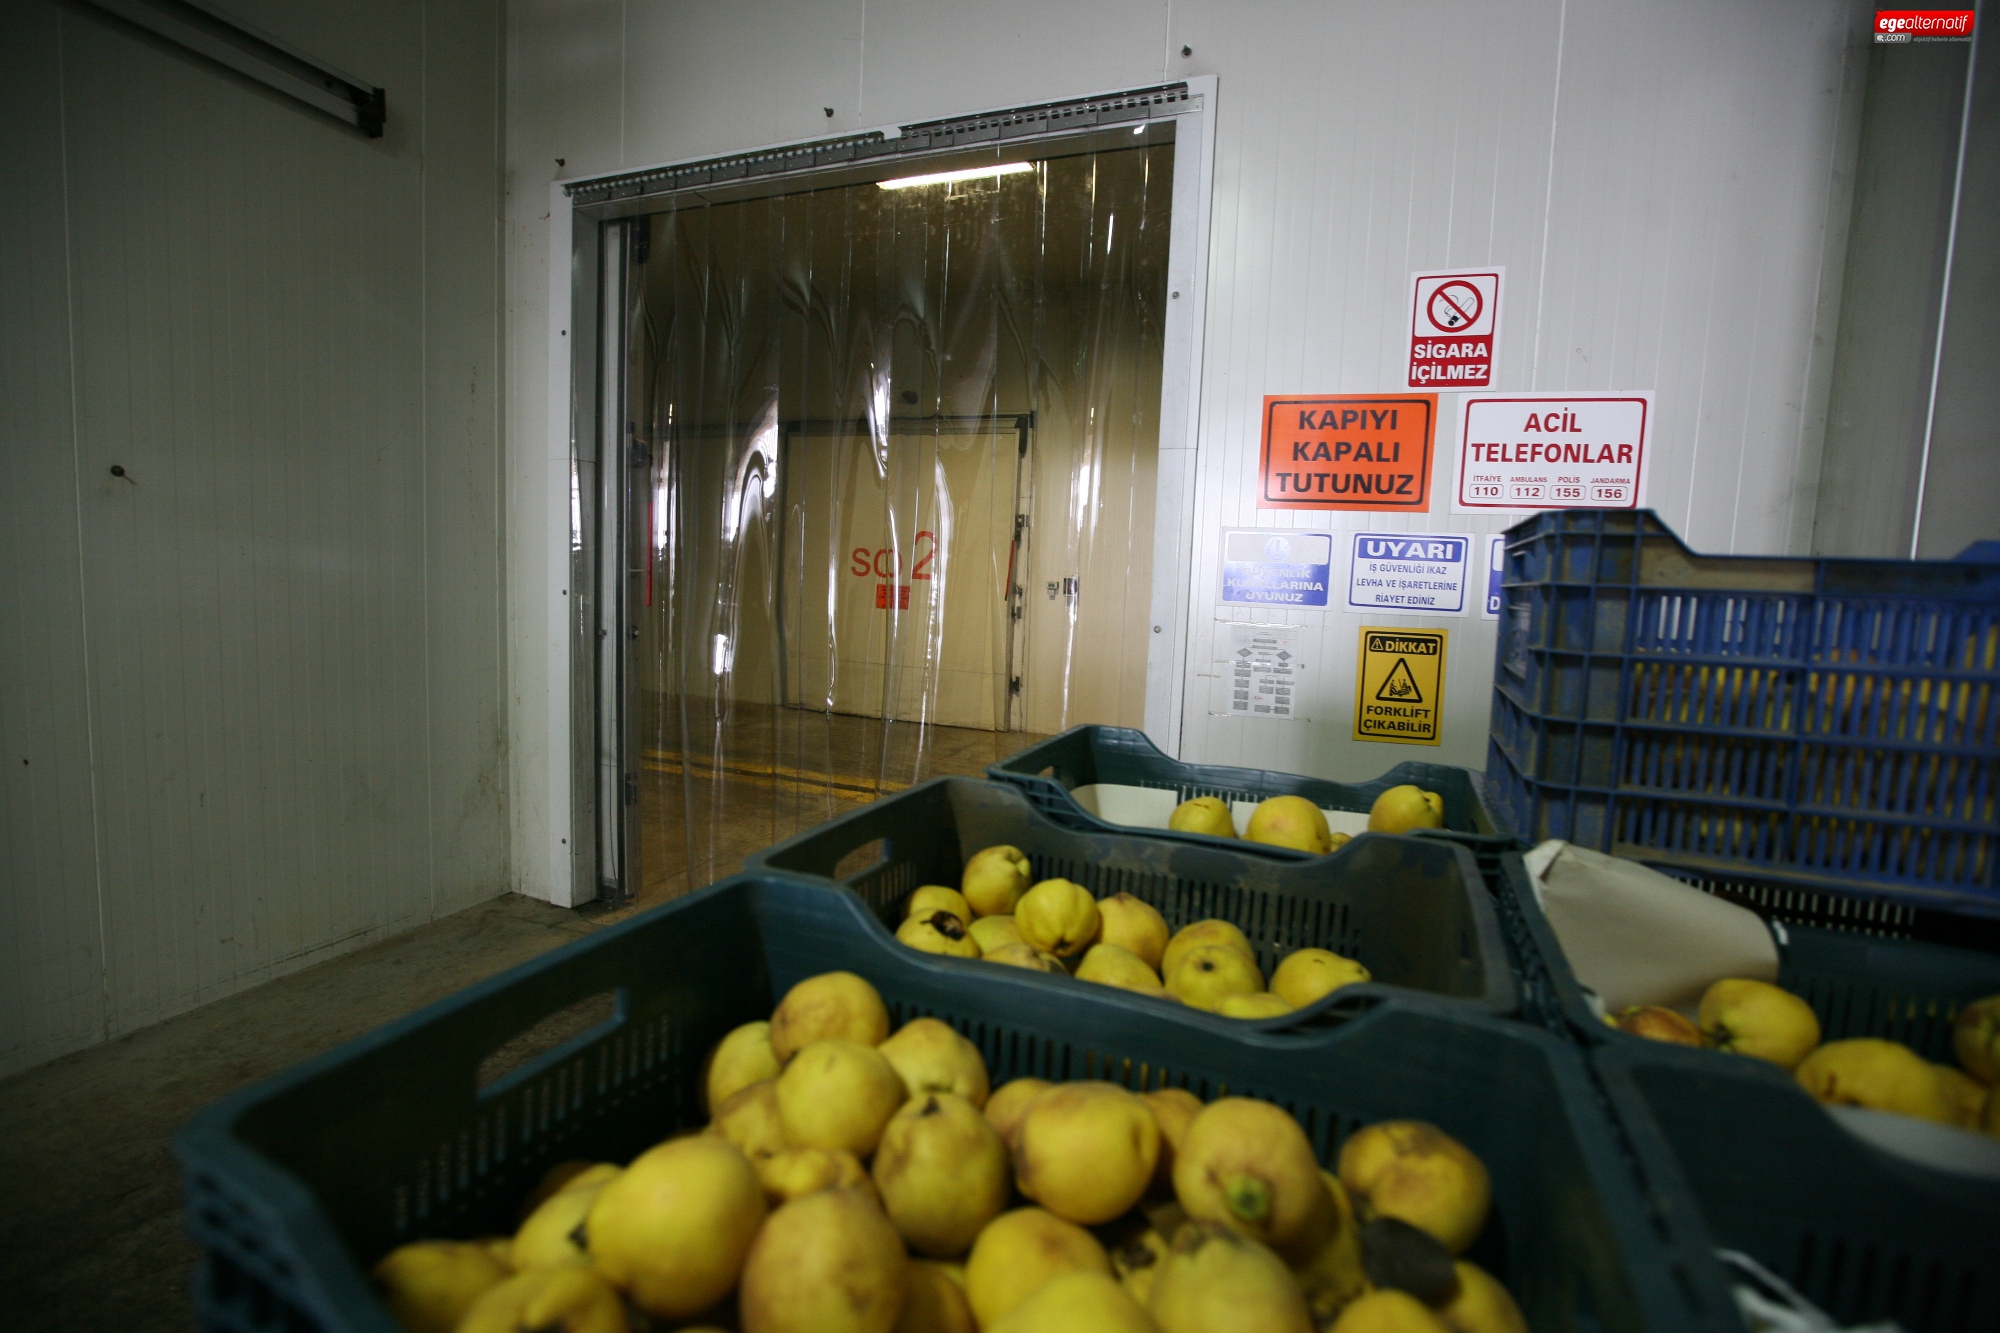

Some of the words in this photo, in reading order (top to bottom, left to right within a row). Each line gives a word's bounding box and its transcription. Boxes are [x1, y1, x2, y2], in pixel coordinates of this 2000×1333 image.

[1413, 340, 1488, 359] SİGARA
[1411, 361, 1488, 384] İÇİLMEZ
[1298, 409, 1398, 431] KAPIYI
[1523, 407, 1582, 433] ACİL
[1292, 441, 1400, 463] KAPALI
[1471, 443, 1633, 464] TELEFONLAR
[1275, 473, 1414, 495] TUTUNUZ
[1472, 474, 1502, 483] İTFAİYE
[1557, 474, 1581, 484] POLİS
[1590, 477, 1631, 485] JANDARMA
[1474, 486, 1499, 496] 110
[1515, 487, 1540, 497] 112
[1555, 487, 1580, 498] 155
[1596, 488, 1622, 499] 156
[1366, 540, 1453, 560] UYARI
[1369, 561, 1377, 573] İŞ
[1379, 562, 1425, 574] GÜVENLİĞİ
[1426, 563, 1447, 575] İKAZ
[1356, 578, 1383, 587] LEVHA
[1386, 579, 1399, 588] VE
[1399, 578, 1458, 591] İŞARETLERİNE
[1245, 590, 1304, 603] UYUNUZ
[1375, 592, 1406, 603] RİAYET
[1407, 594, 1436, 605] EDİNİZ
[1385, 638, 1436, 654] DİKKAT
[1366, 704, 1431, 719] FORKLİFT
[1363, 718, 1431, 733] ÇIKABİLİR
